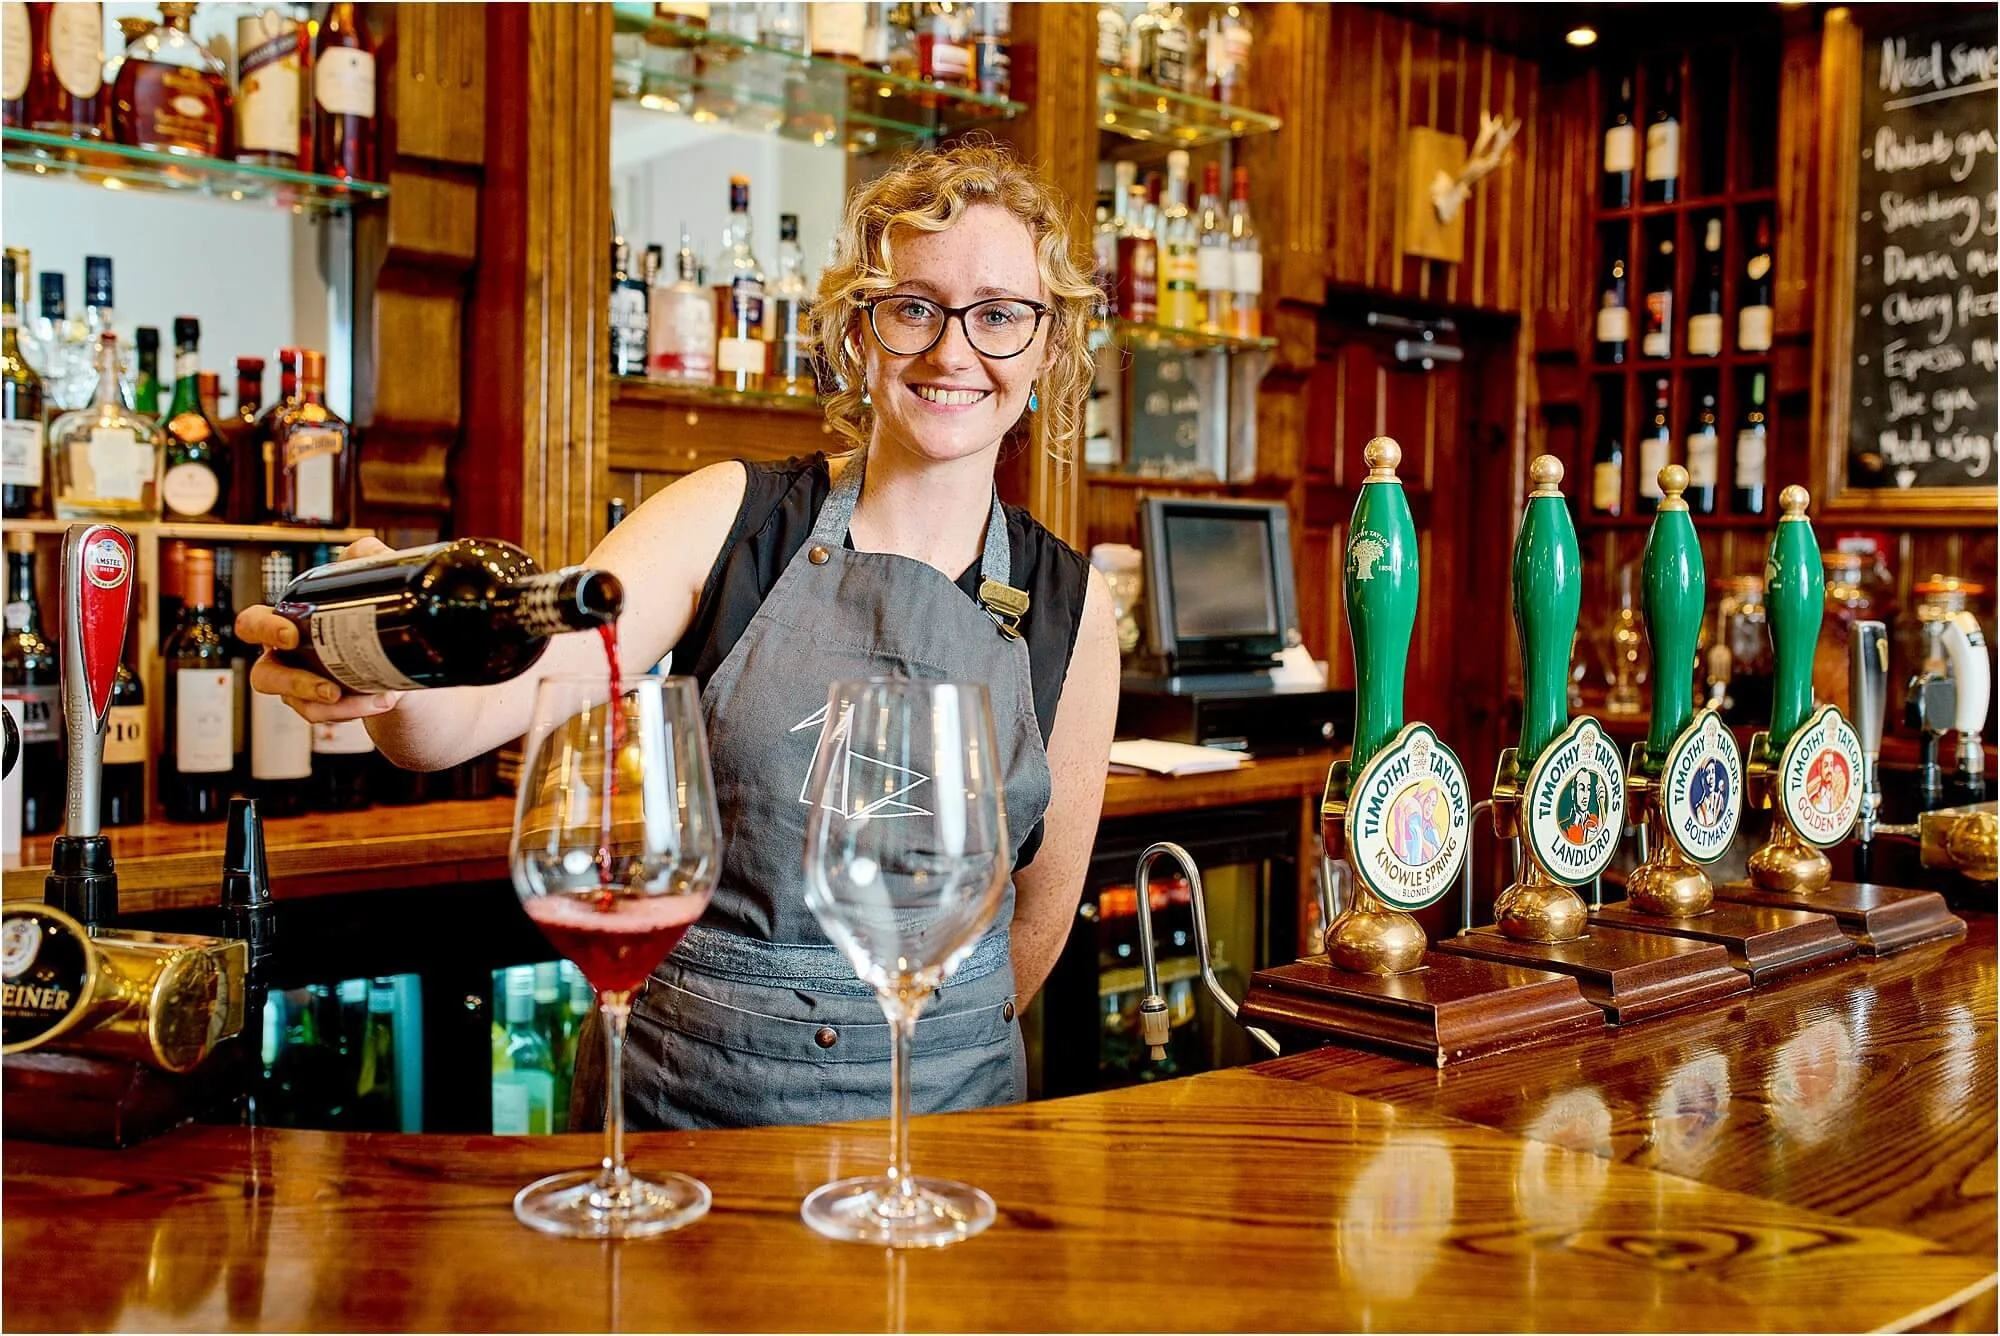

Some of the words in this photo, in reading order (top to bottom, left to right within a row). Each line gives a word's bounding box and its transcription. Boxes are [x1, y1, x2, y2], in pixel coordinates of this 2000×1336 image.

[70, 694, 84, 750] QUALITY
[69, 755, 84, 819] PREMIUM
[1539, 744, 1580, 820] TIMOTHY
[1594, 742, 1620, 812] TAYLOR'S
[1674, 734, 1706, 805] TIMOTHY
[1717, 734, 1739, 795] TAYLOR'S
[1791, 728, 1826, 792] TIMOTHY
[1838, 728, 1862, 786] TAYLOR'S
[1365, 753, 1411, 838] TIMOTHY
[1430, 752, 1465, 829] TAYLOR'S
[1798, 796, 1834, 832] GOLDEN
[1837, 795, 1855, 825] BEST
[1551, 828, 1610, 867] LANDLORD
[1684, 809, 1735, 847] BOLTMAKER
[1375, 847, 1422, 887] KNOWLE
[1425, 836, 1457, 883] SPRING
[1402, 885, 1431, 898] BLONDE
